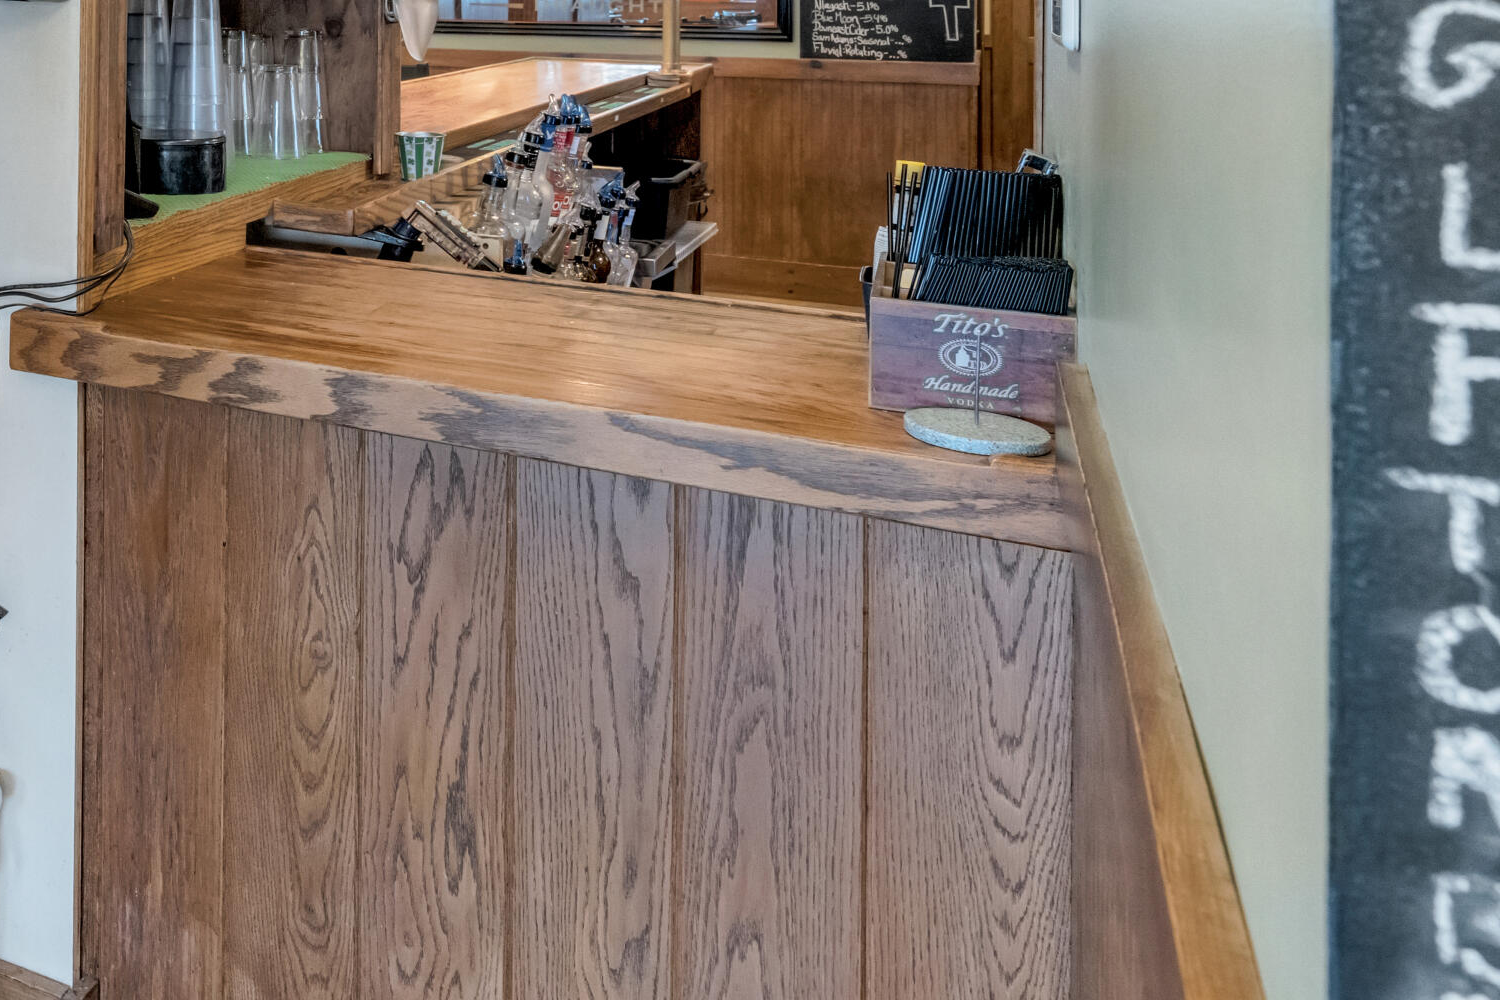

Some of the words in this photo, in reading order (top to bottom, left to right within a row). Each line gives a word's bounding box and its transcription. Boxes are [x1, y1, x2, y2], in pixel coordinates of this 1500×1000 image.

[812, 10, 834, 22] Blue
[933, 312, 1009, 339] Tito's
[923, 374, 1019, 399] Handmade
